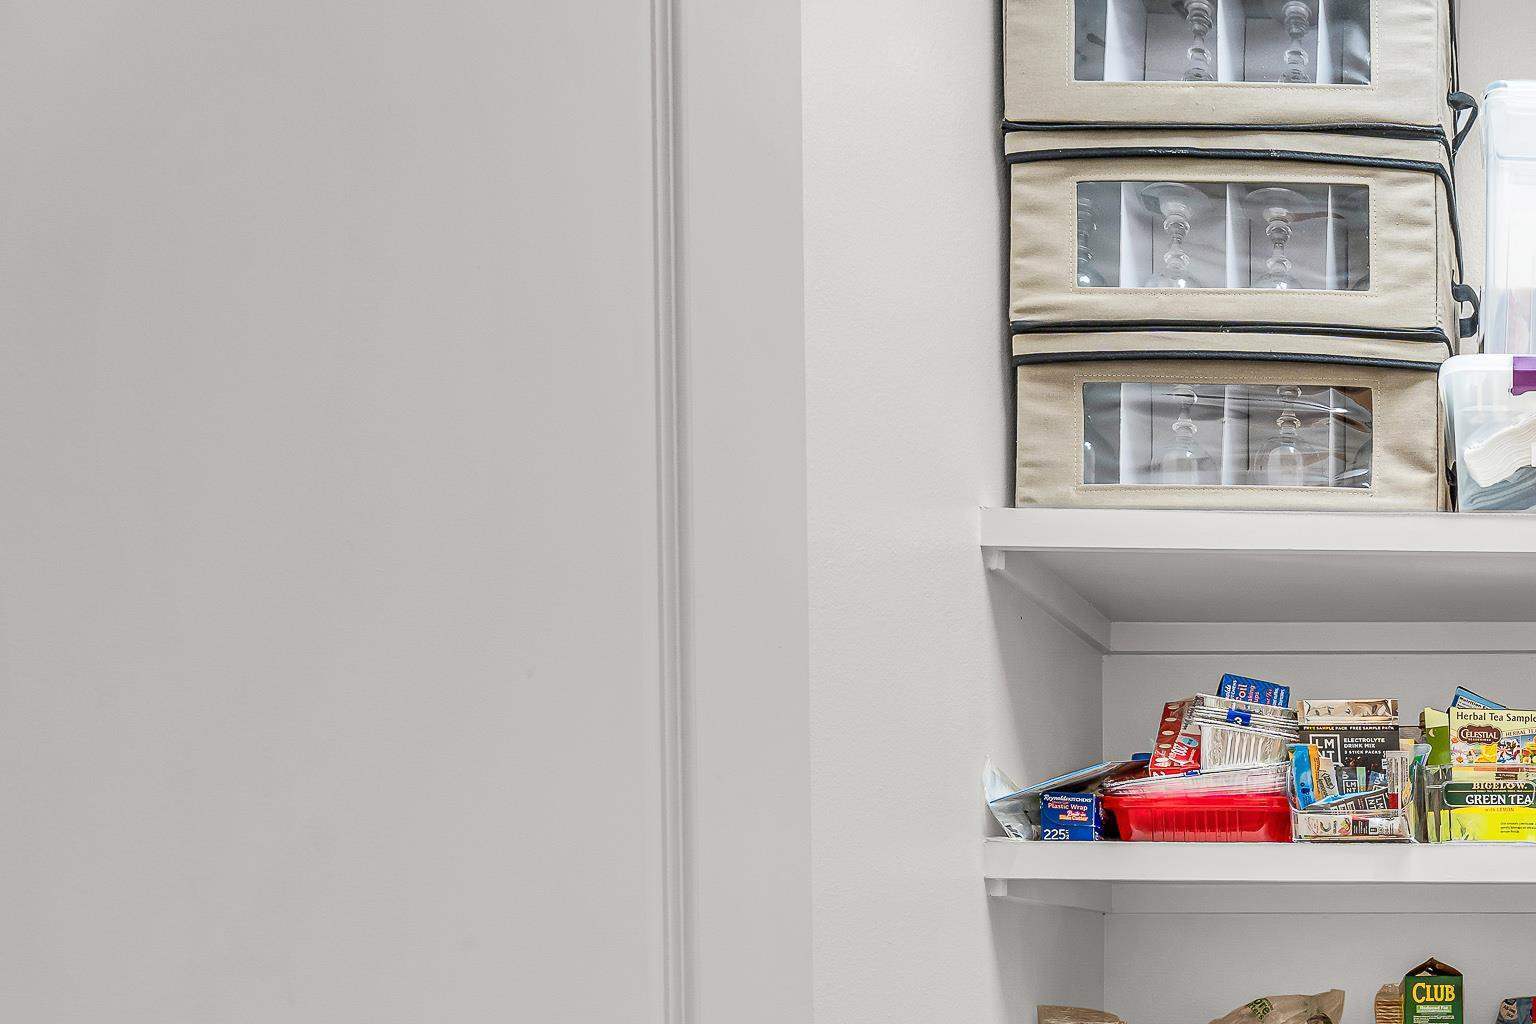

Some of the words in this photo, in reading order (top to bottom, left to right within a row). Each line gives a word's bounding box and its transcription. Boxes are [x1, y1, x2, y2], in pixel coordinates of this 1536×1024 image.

[1456, 712, 1487, 722] Herbal
[1489, 712, 1504, 722] Tea
[1460, 729, 1498, 739] CELESTIAL
[1315, 738, 1335, 749] LM
[1465, 794, 1506, 805] GREEN
[1508, 794, 1532, 805] TEA
[1070, 803, 1088, 812] Wrap
[1043, 829, 1065, 841] 225
[1412, 982, 1455, 1003] CLUB
